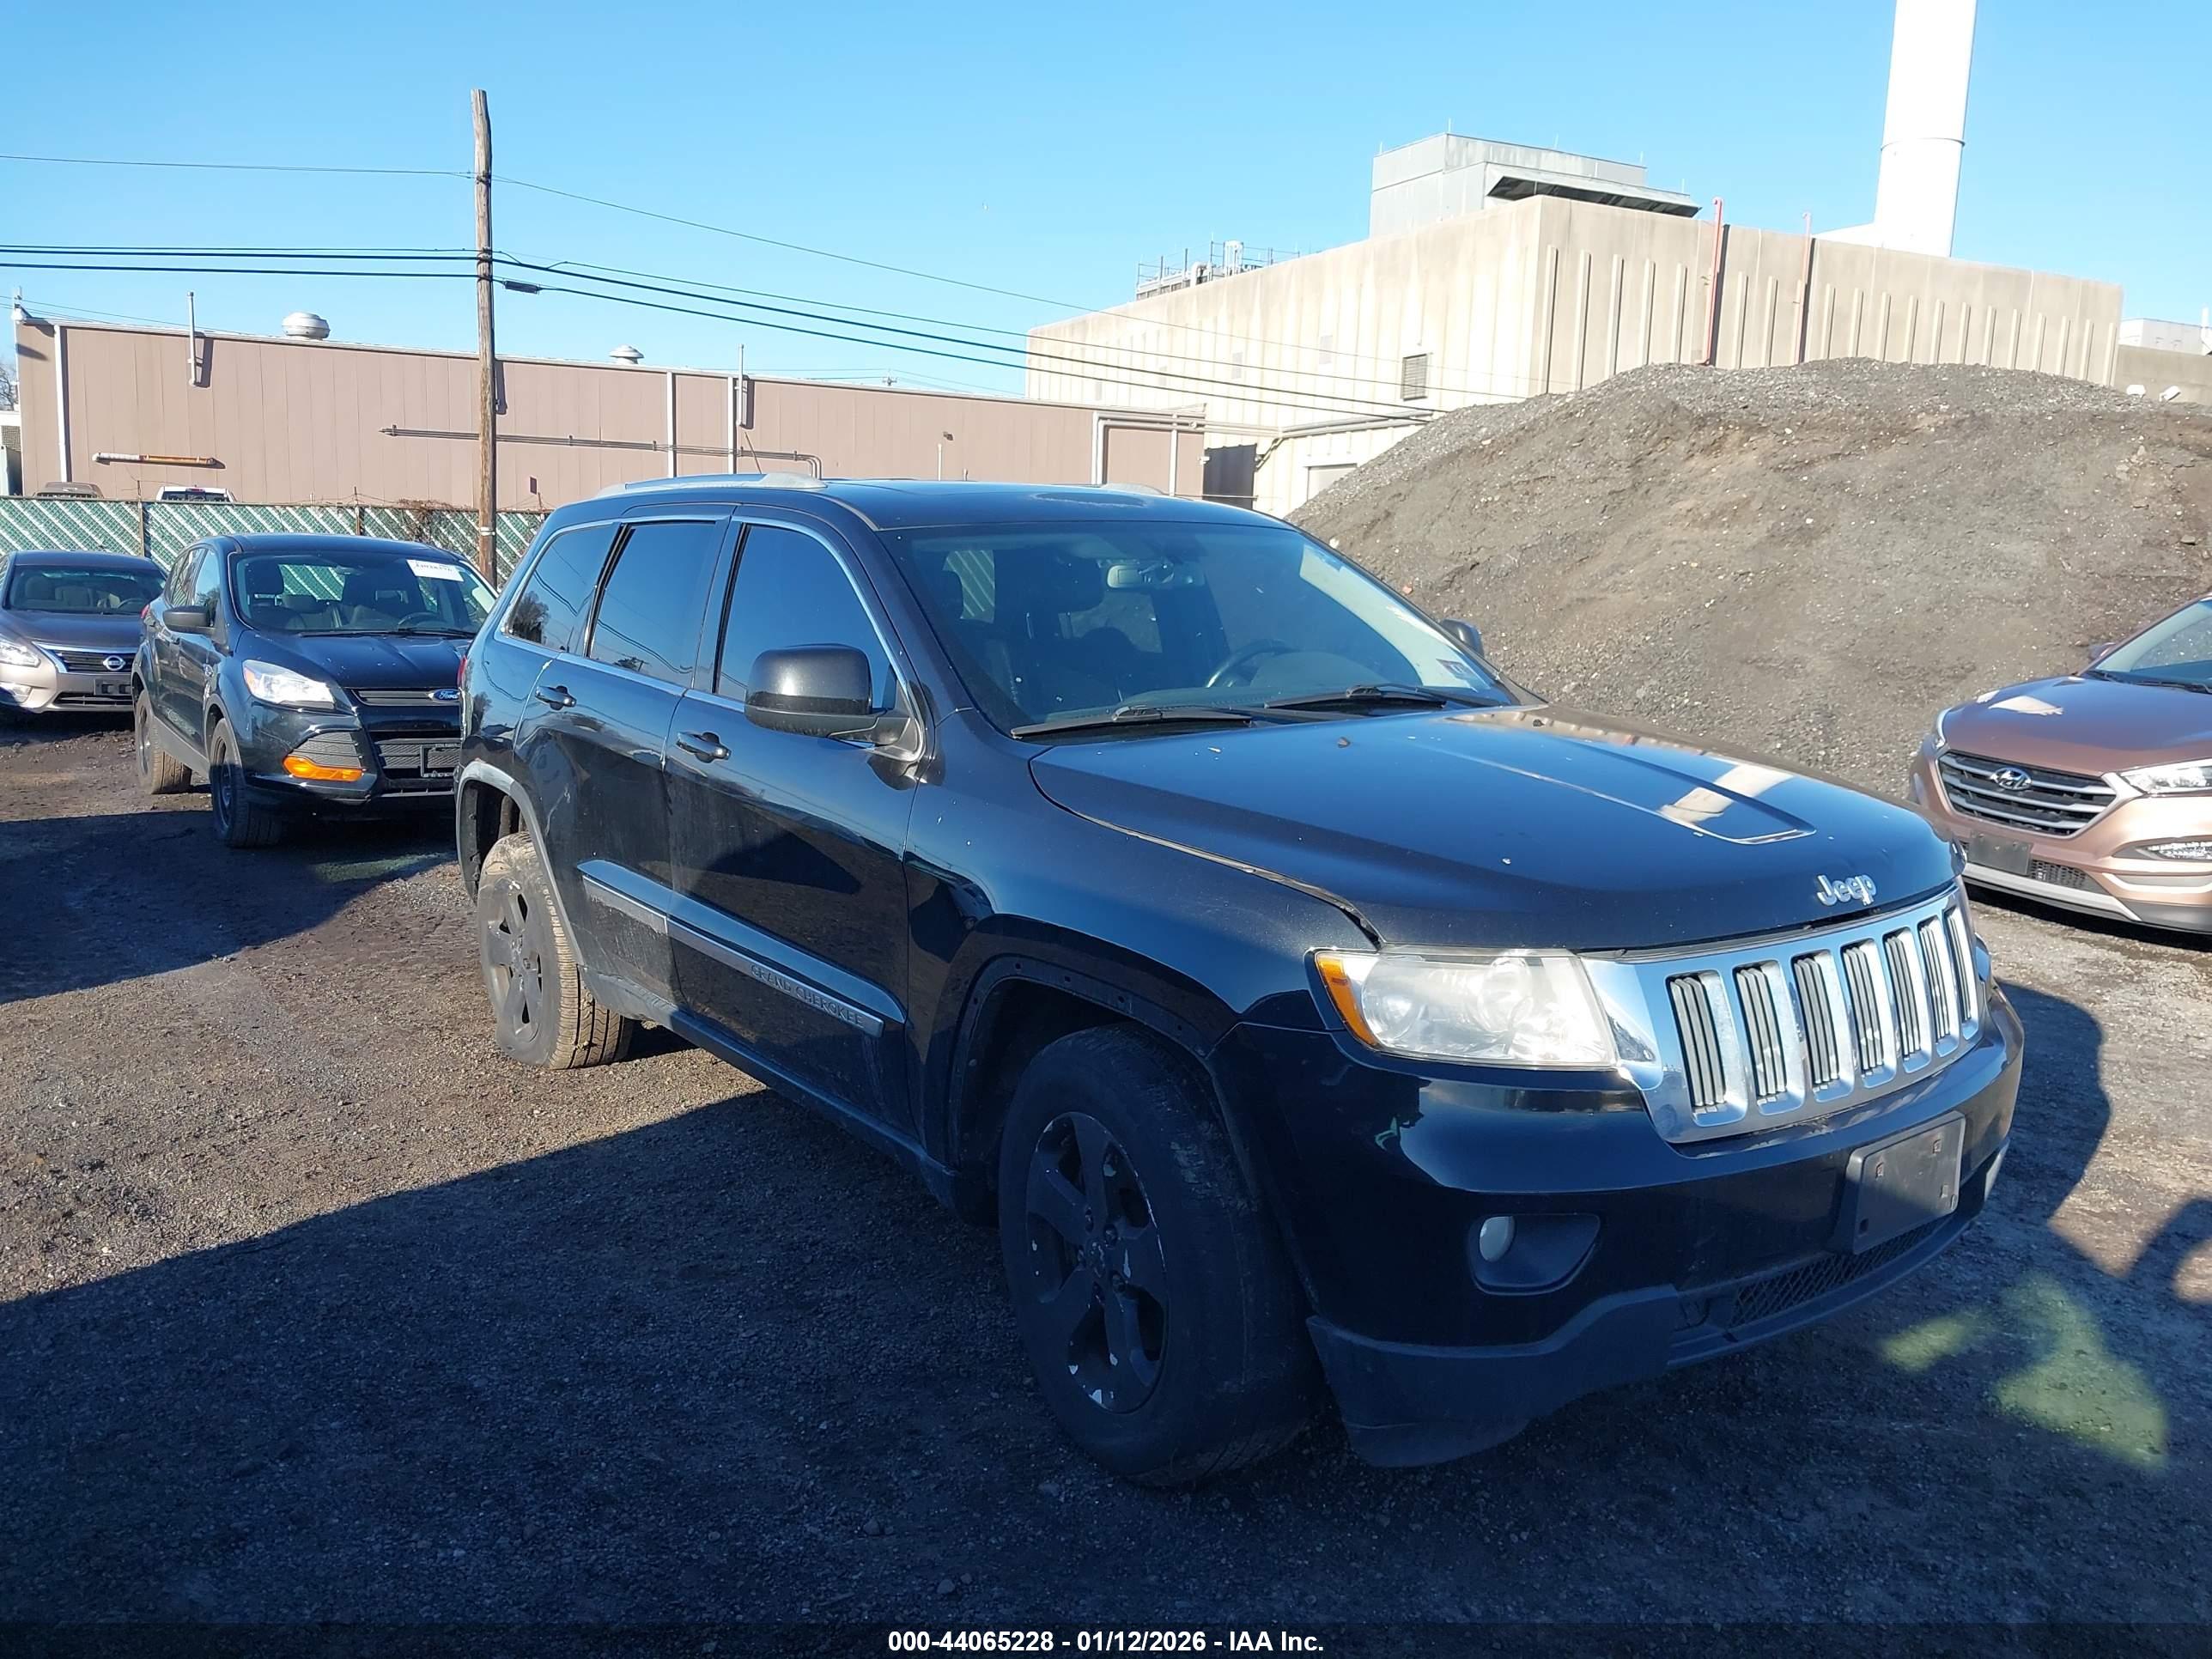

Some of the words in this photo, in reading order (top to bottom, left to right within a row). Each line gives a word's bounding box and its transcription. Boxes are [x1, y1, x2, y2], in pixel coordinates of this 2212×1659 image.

[439, 690, 460, 700] Ford
[1816, 874, 1877, 906] Jeep
[750, 964, 791, 994] GRAND
[795, 987, 865, 1029] CHEROKEE
